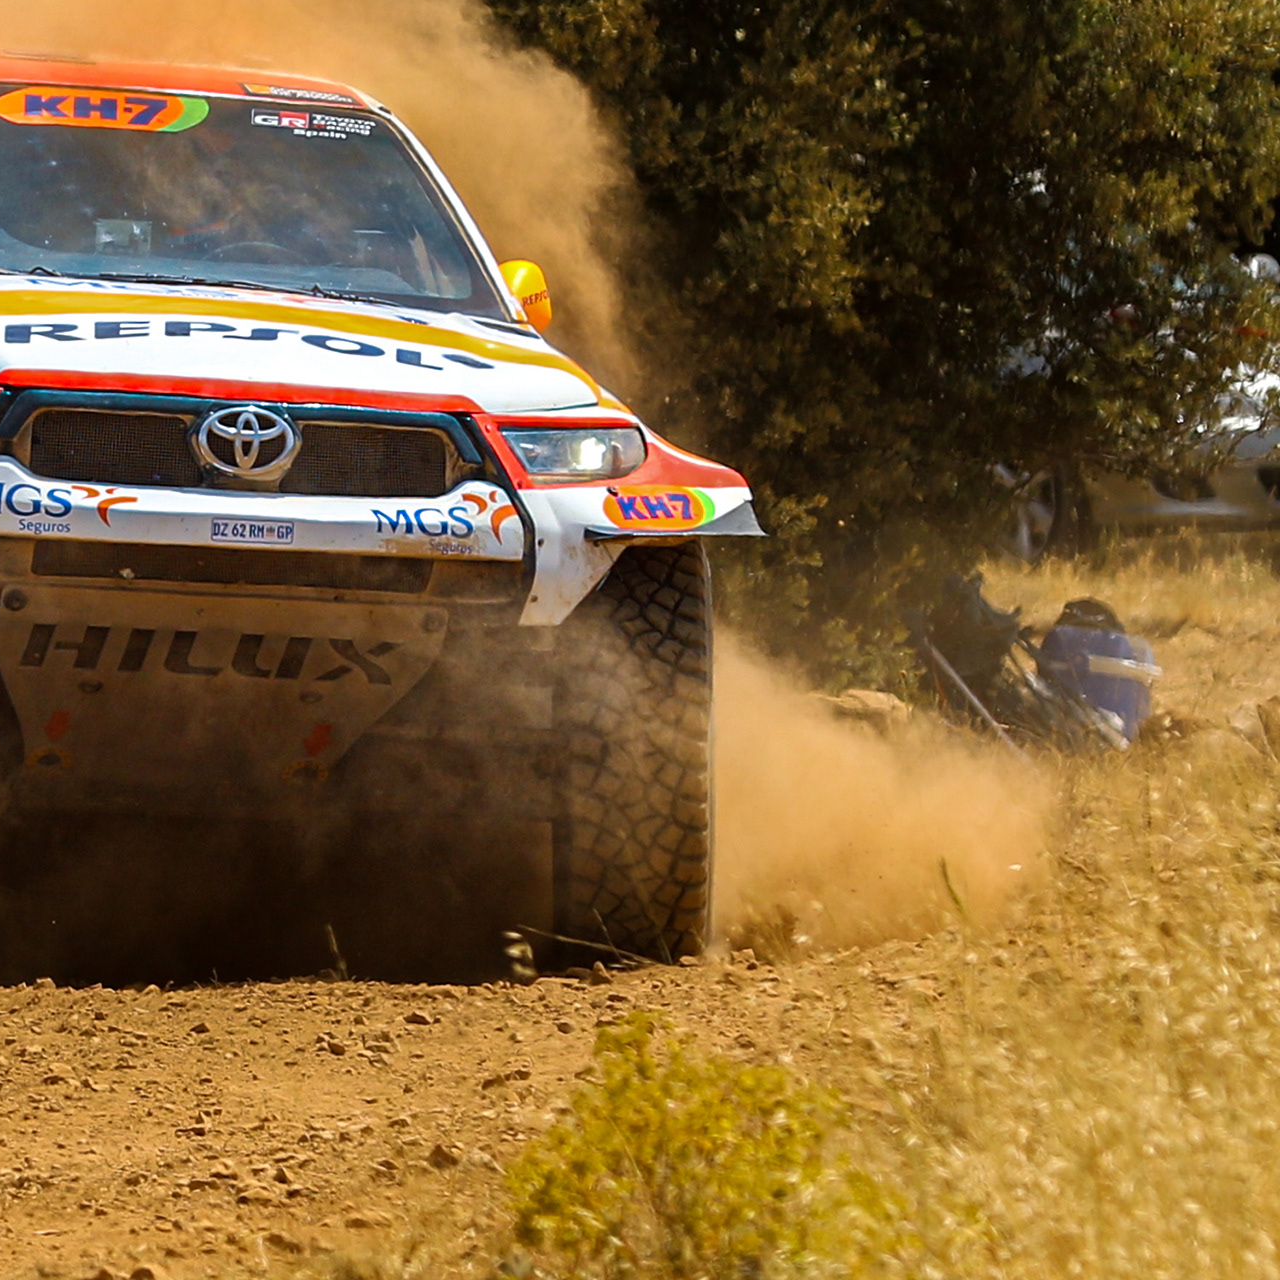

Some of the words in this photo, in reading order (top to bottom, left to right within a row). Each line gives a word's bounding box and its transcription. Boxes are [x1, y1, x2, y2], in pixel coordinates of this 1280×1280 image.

[24, 94, 169, 126] KH-7
[253, 114, 307, 129] GR
[293, 128, 347, 140] Spain
[3, 320, 444, 371] REPSOL
[615, 492, 694, 521] KH-7
[18, 518, 71, 535] Seguros
[213, 522, 229, 537] DZ
[231, 523, 246, 538] 62
[276, 525, 293, 540] GP
[370, 506, 474, 539] MGS
[19, 623, 406, 687] HILUX
